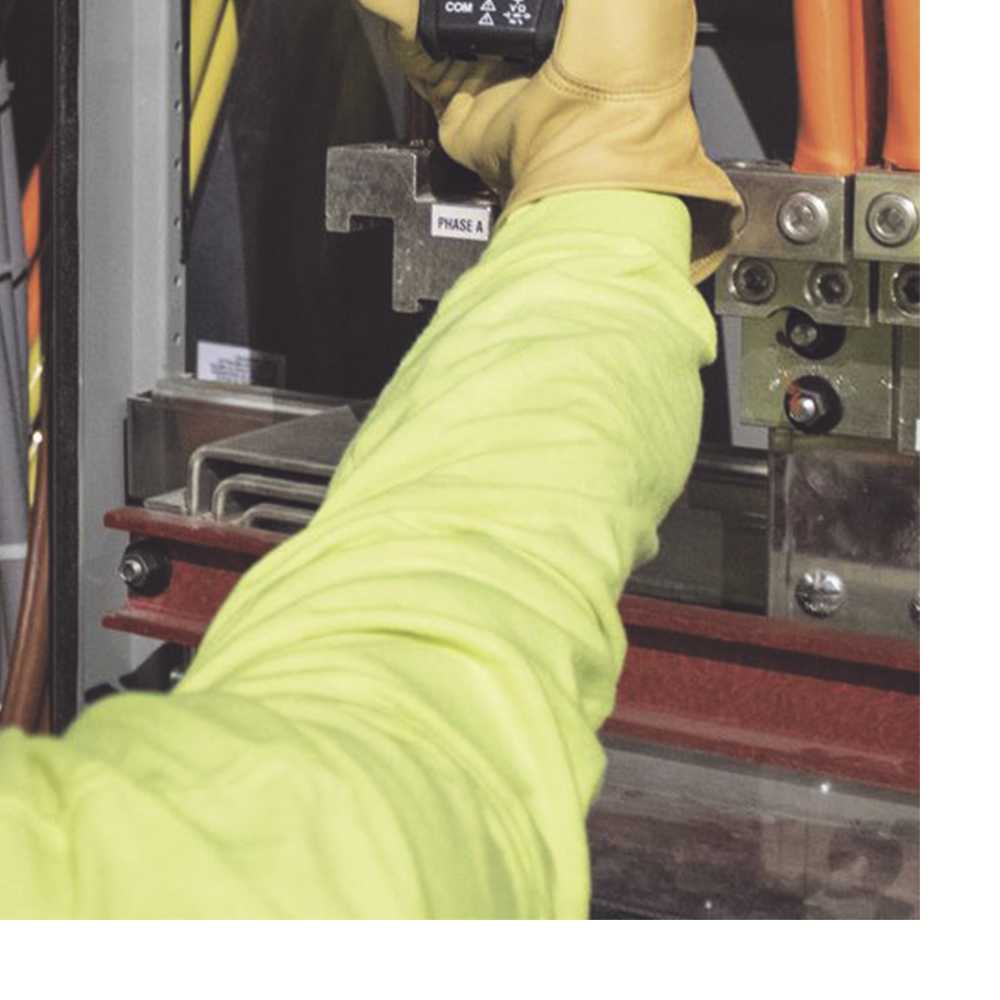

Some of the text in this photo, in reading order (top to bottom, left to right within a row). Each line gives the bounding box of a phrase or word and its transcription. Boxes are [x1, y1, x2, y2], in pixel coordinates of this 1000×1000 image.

[445, 1, 473, 13] COM
[437, 216, 484, 233] PHASE A
